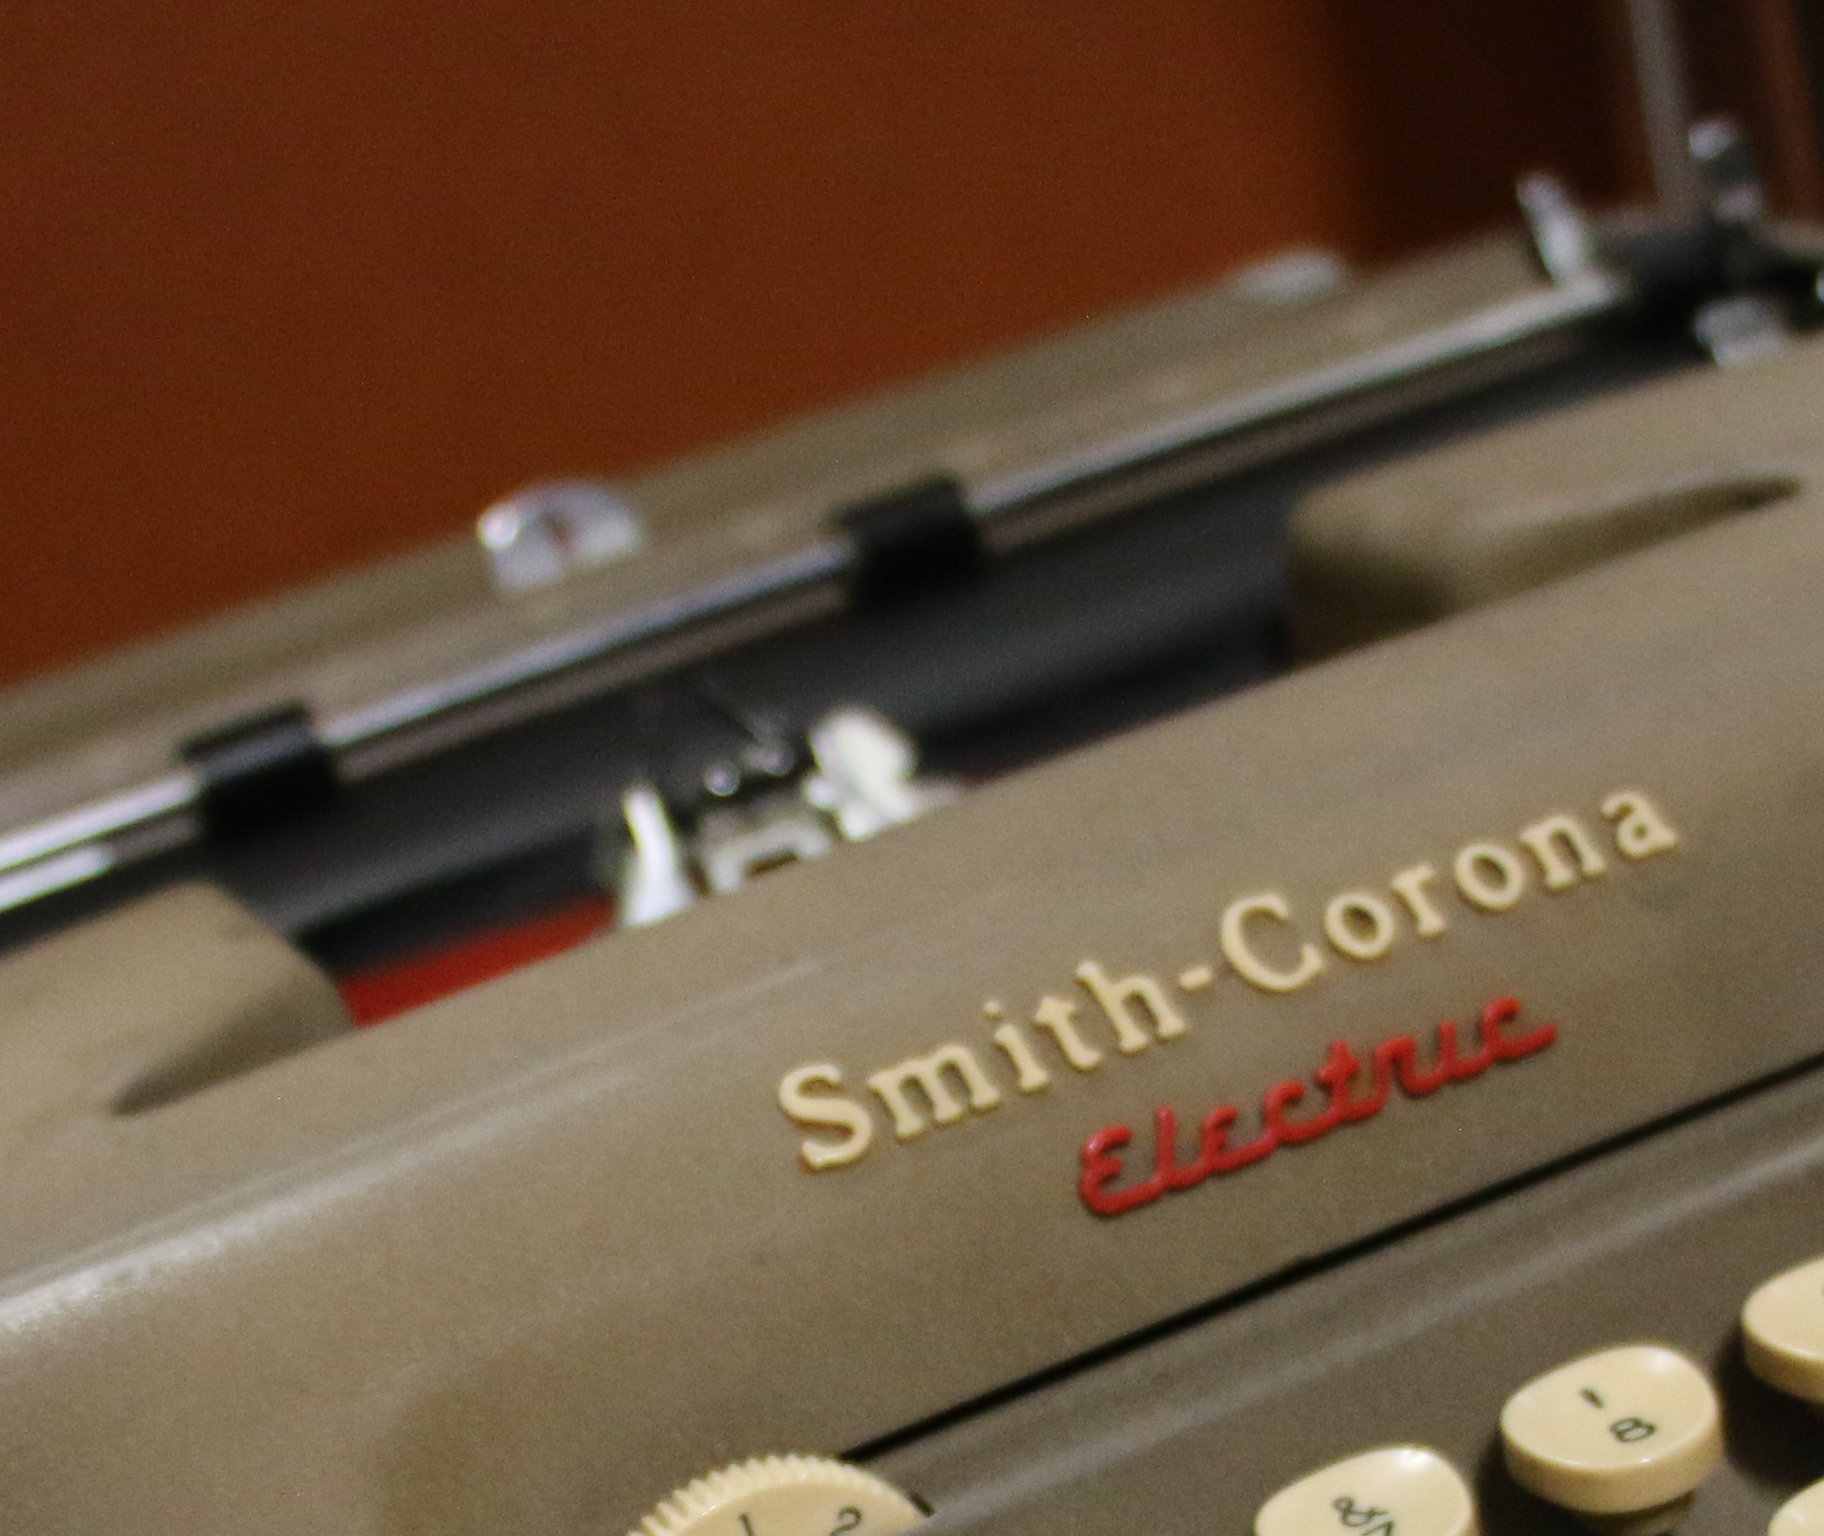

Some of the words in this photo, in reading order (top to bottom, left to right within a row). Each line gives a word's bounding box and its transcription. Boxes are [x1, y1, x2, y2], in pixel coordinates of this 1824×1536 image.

[777, 789, 1680, 1172] Smith-Corona
[1078, 995, 1559, 1216] Electric
[1610, 1416, 1658, 1443] 8
[1332, 1496, 1389, 1528] &
